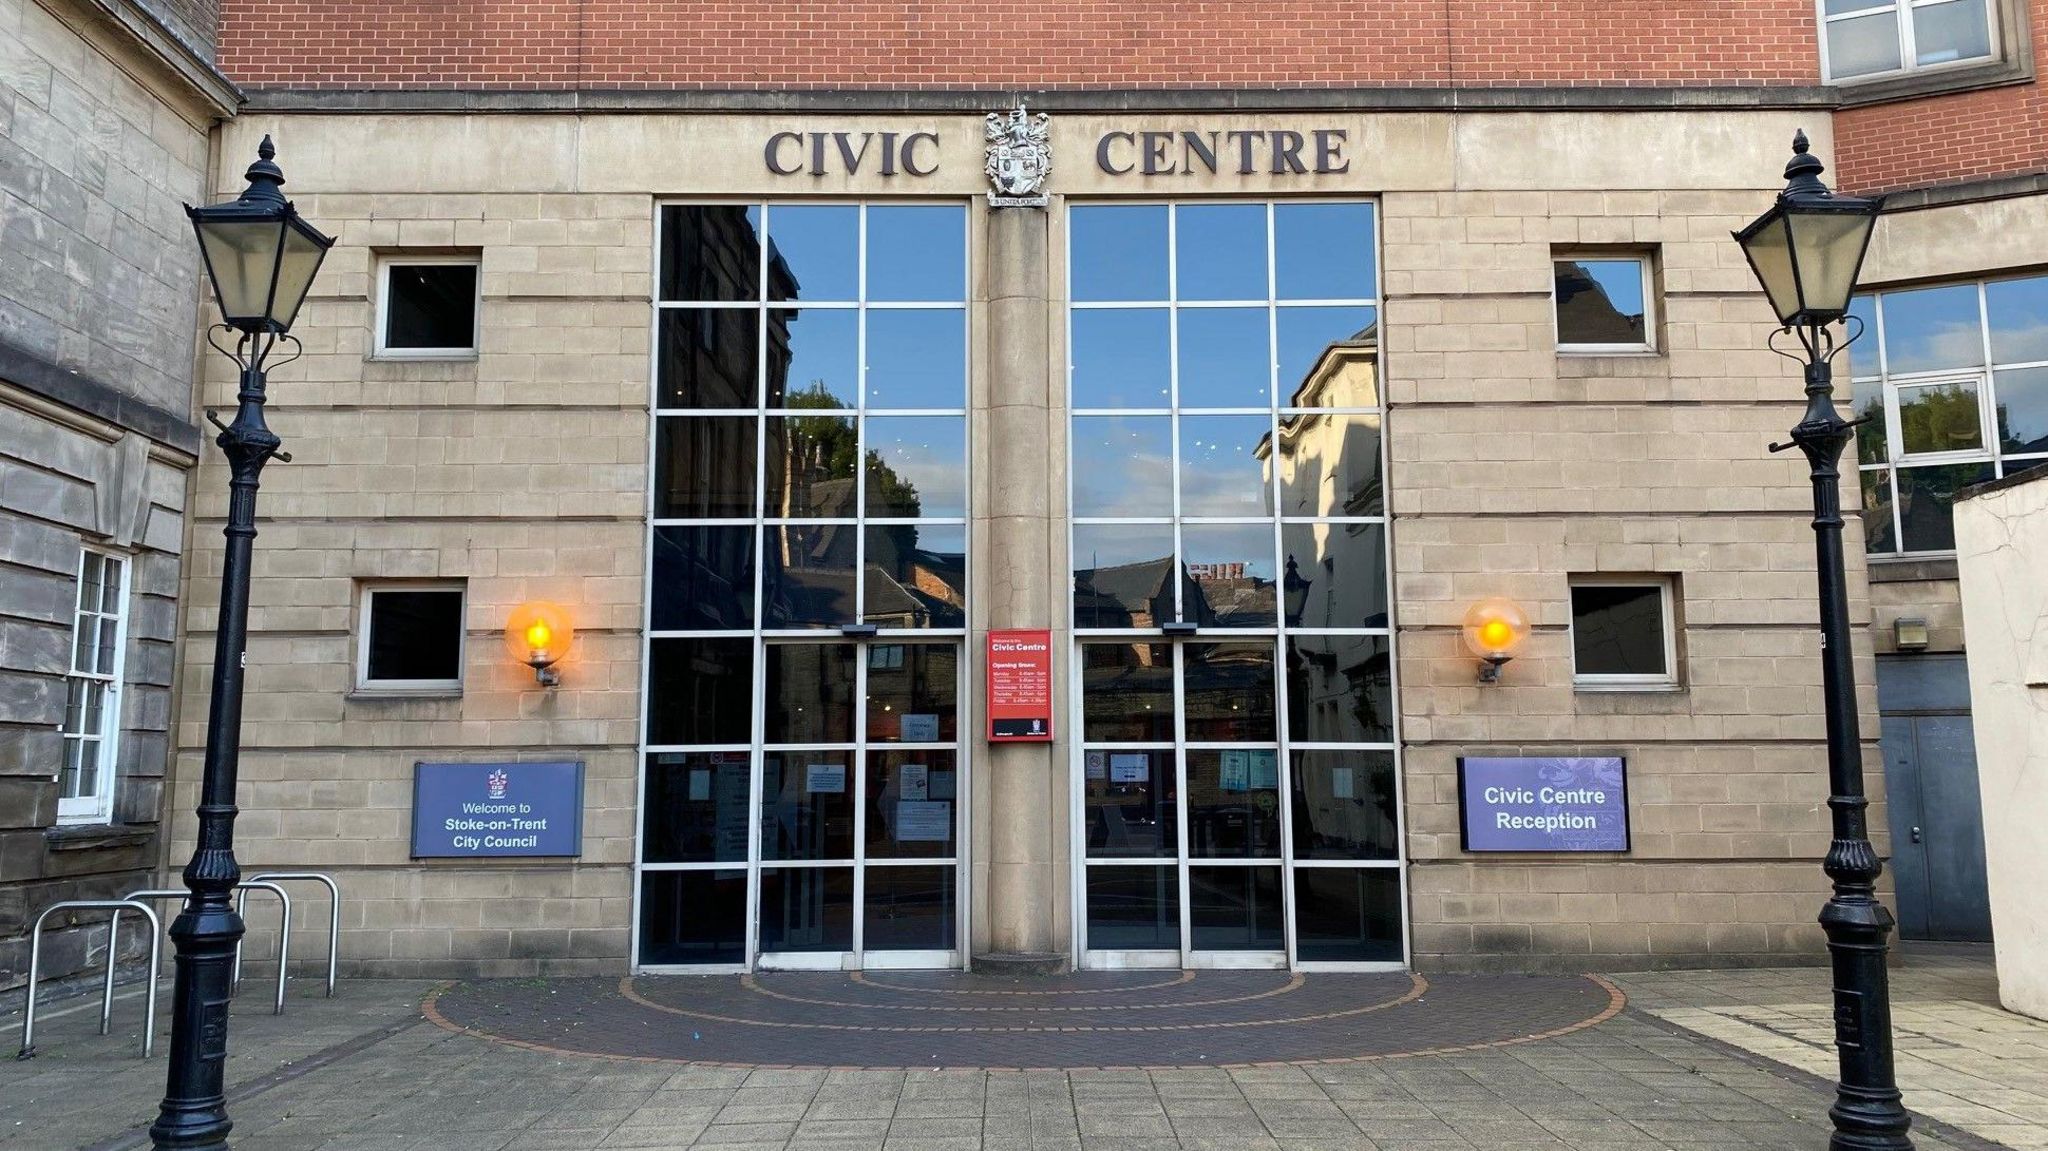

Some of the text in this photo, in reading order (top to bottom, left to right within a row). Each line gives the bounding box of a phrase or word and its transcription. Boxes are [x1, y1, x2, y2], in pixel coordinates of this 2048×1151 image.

[764, 128, 1352, 177] CIVIC CENTRE
[992, 643, 1047, 651] Civic Centre
[992, 662, 1017, 670] Opening
[1484, 786, 1606, 805] Civic Centre
[462, 802, 531, 815] Welcome to
[444, 817, 547, 831] Stoke-on-Trent
[1496, 811, 1597, 833] Reception
[453, 835, 538, 850] City Council
